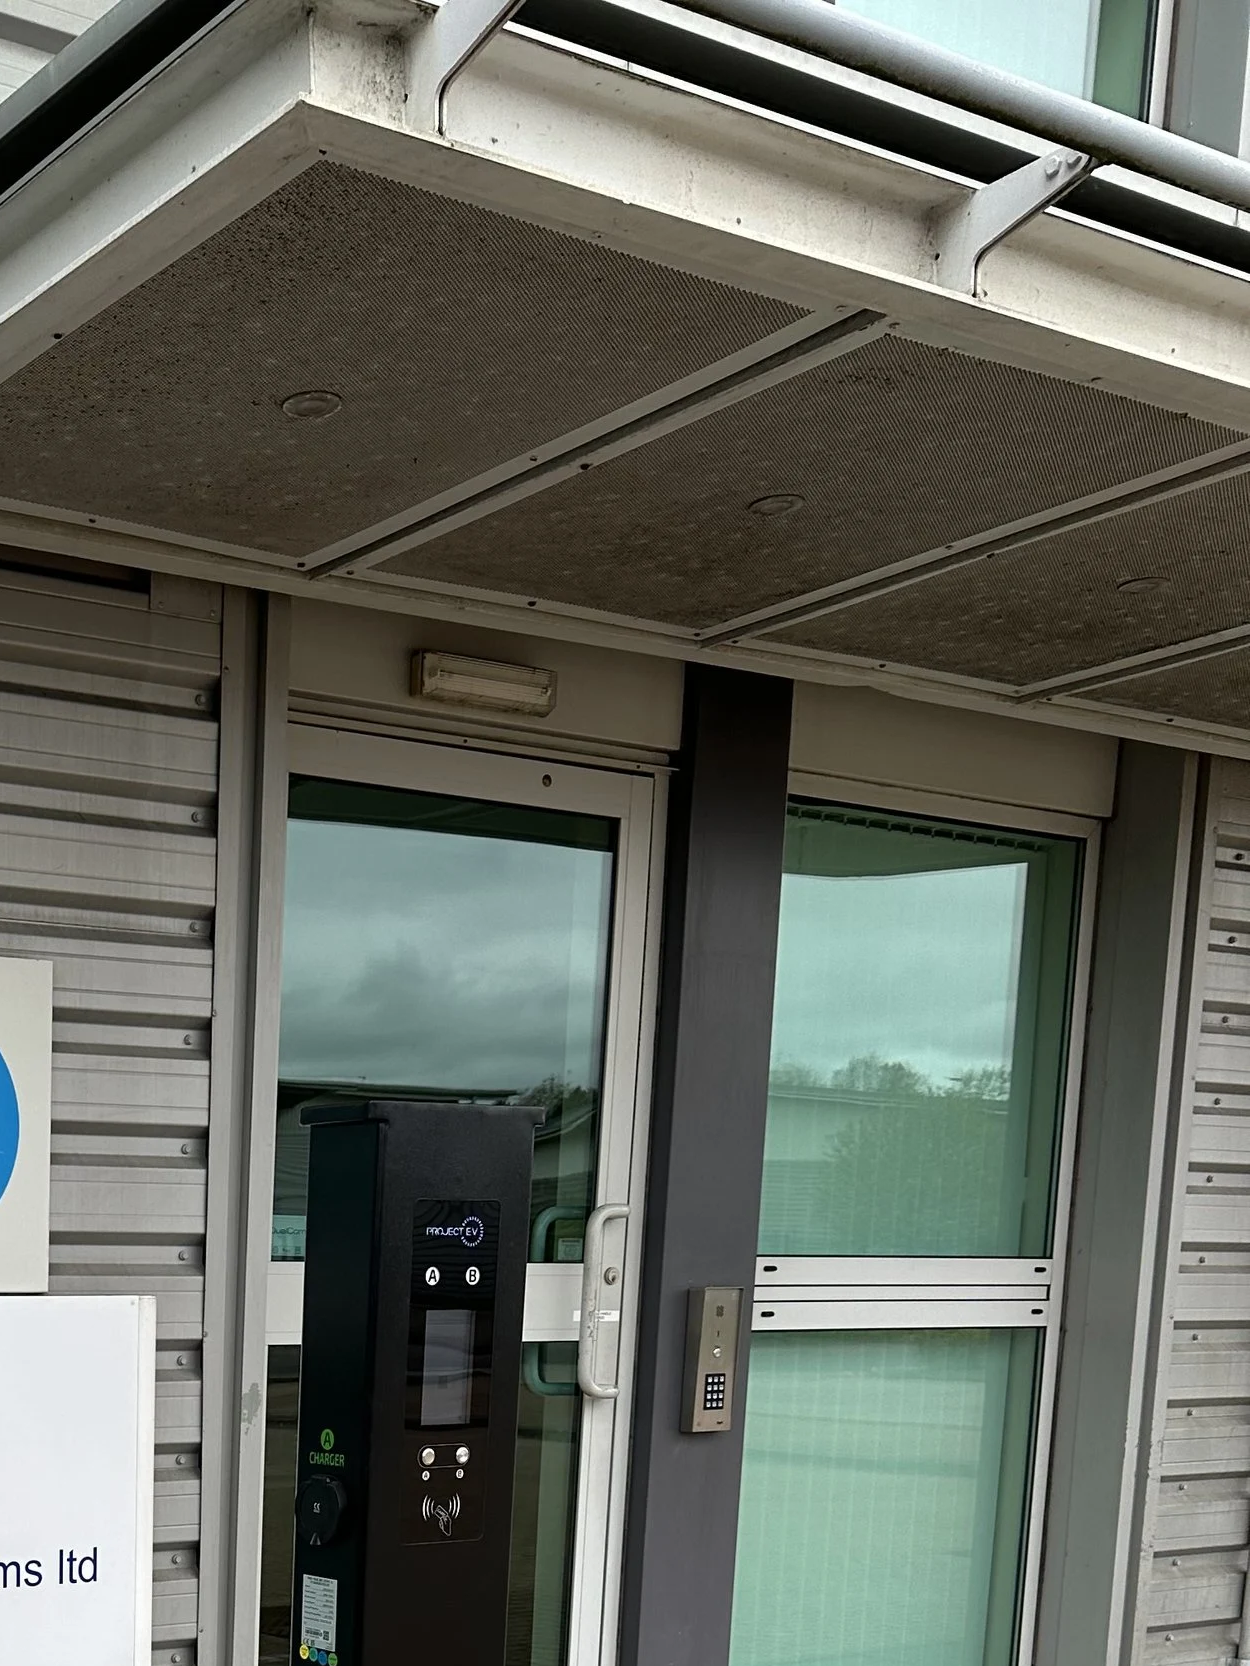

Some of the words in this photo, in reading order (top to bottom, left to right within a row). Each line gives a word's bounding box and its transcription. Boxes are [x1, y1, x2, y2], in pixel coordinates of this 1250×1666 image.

[426, 1226, 464, 1236] PROJECT
[465, 1227, 478, 1236] EV
[309, 1451, 345, 1468] CHARGER
[58, 1547, 98, 1584] ltd
